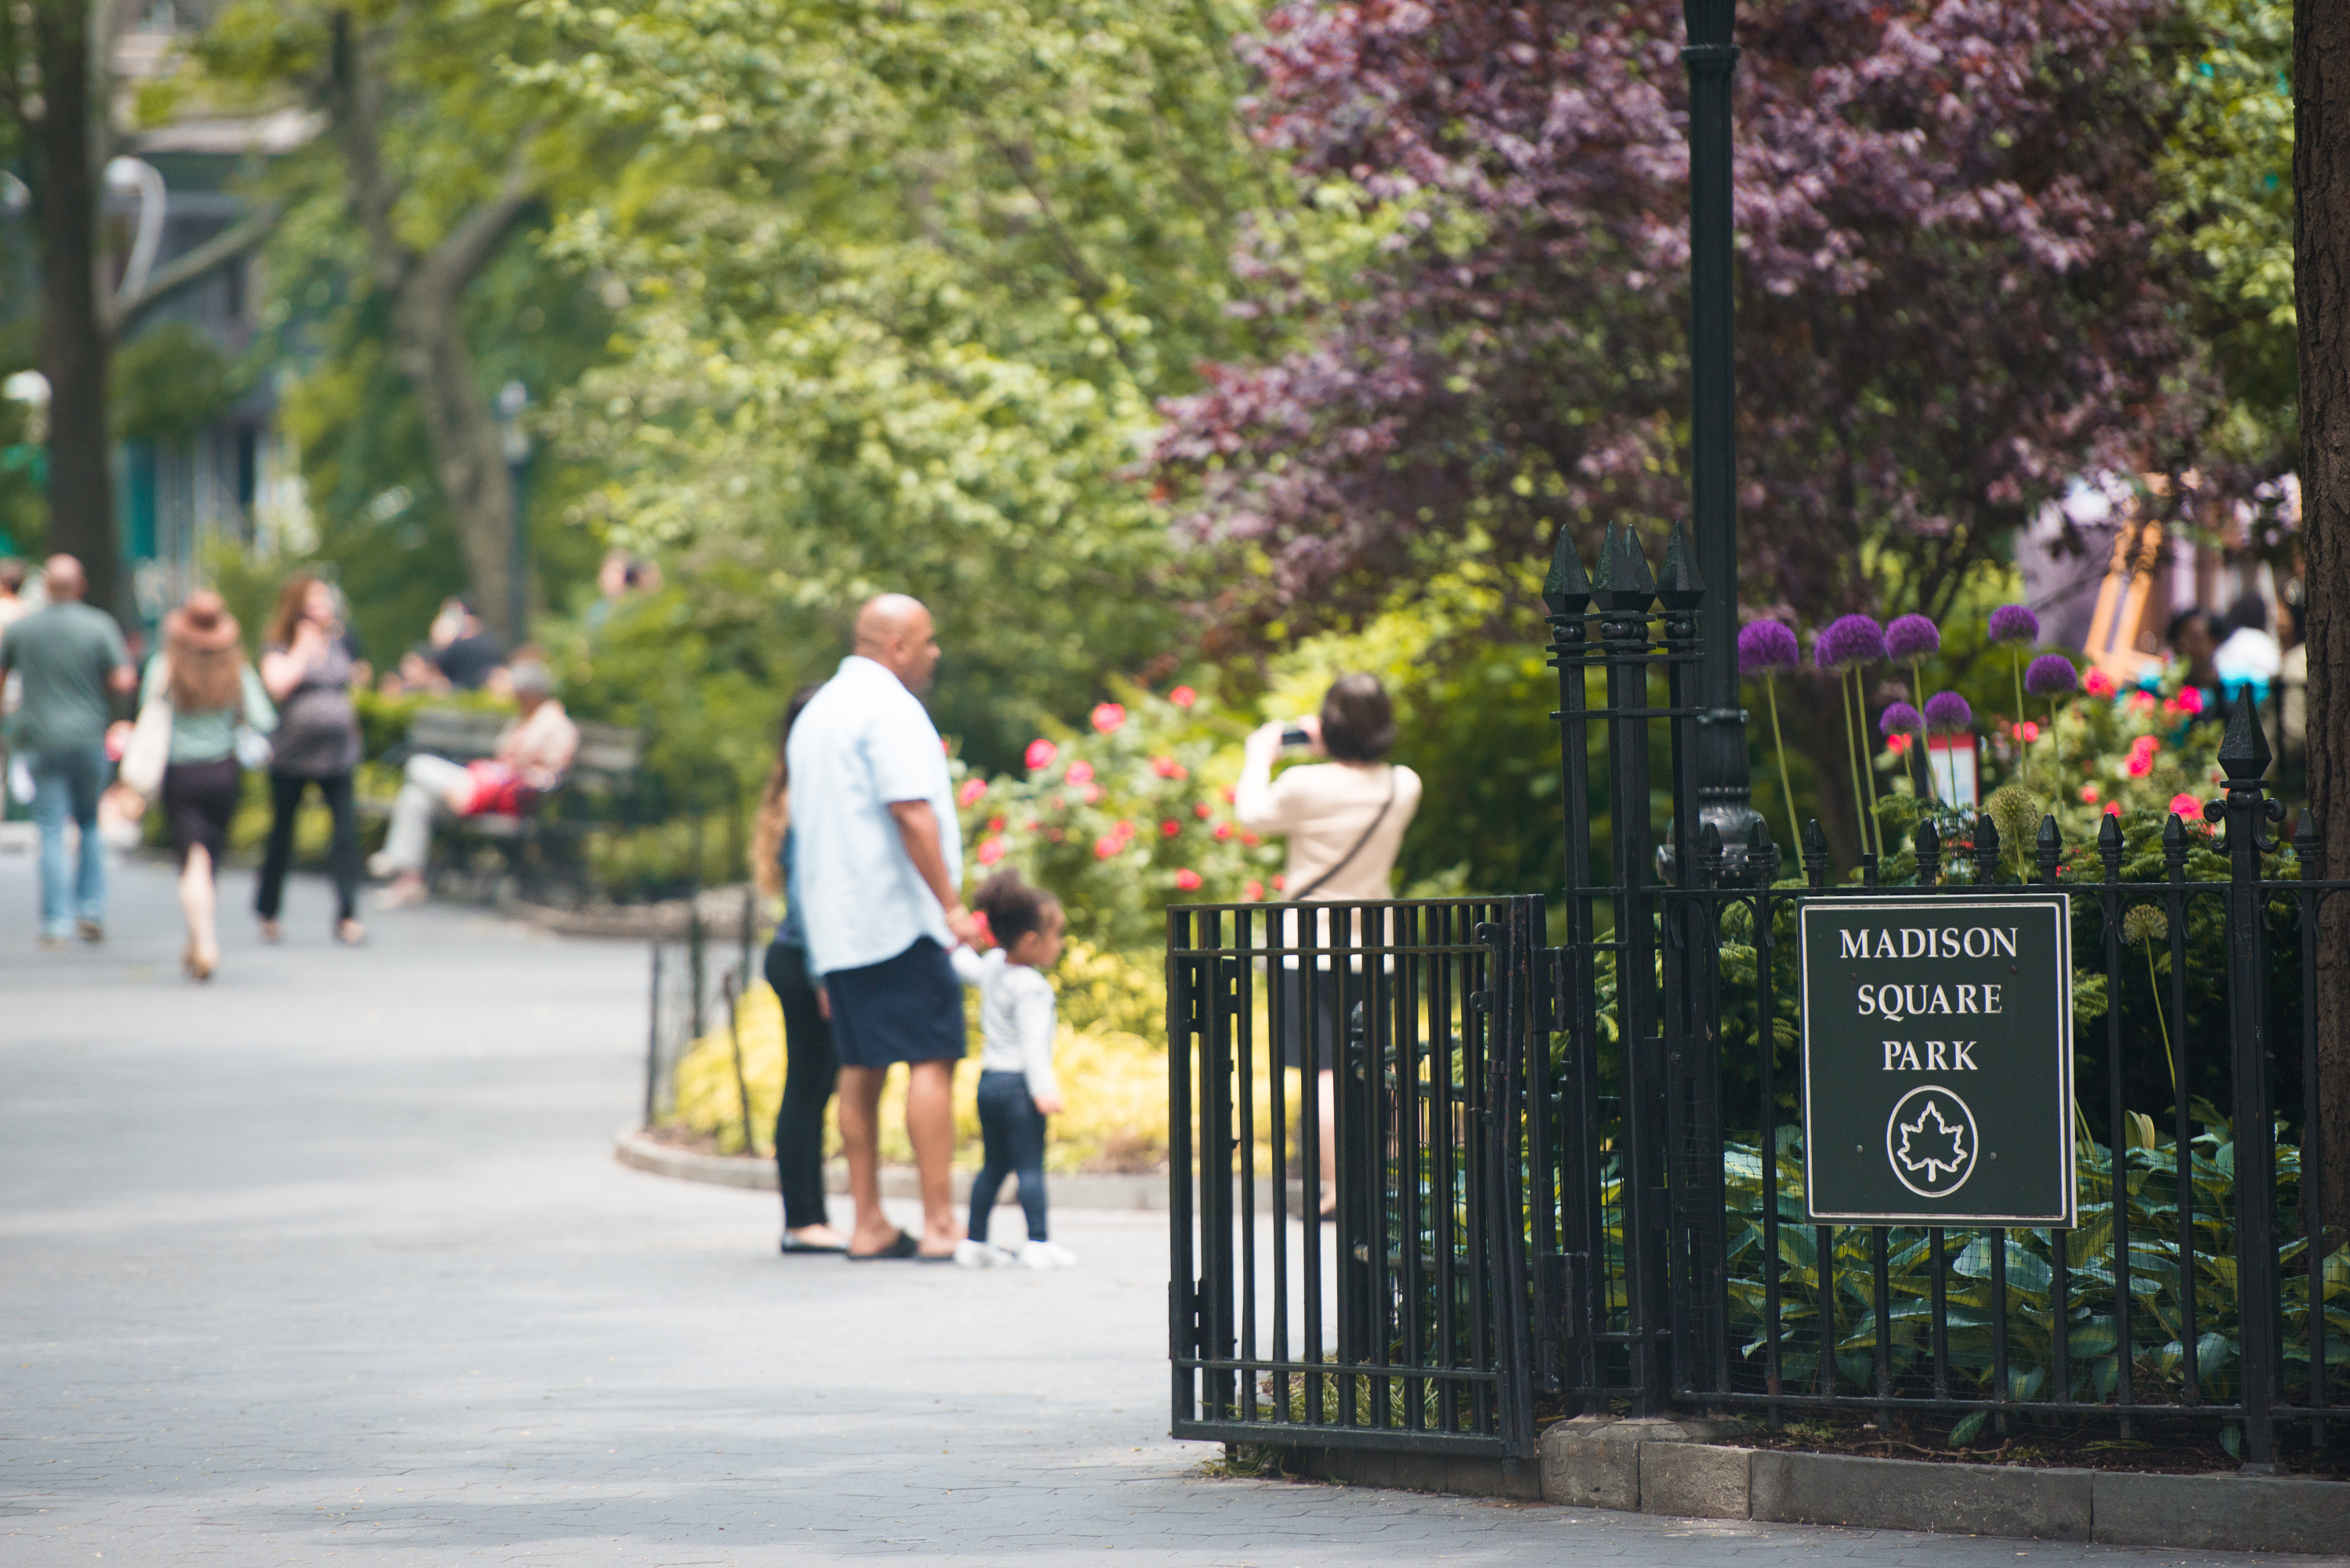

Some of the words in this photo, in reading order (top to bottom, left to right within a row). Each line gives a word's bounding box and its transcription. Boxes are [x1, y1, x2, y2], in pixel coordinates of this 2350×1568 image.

[1839, 927, 2019, 959] MADISON
[1858, 984, 2002, 1022] SQUARE
[1882, 1040, 1979, 1071] PARK
